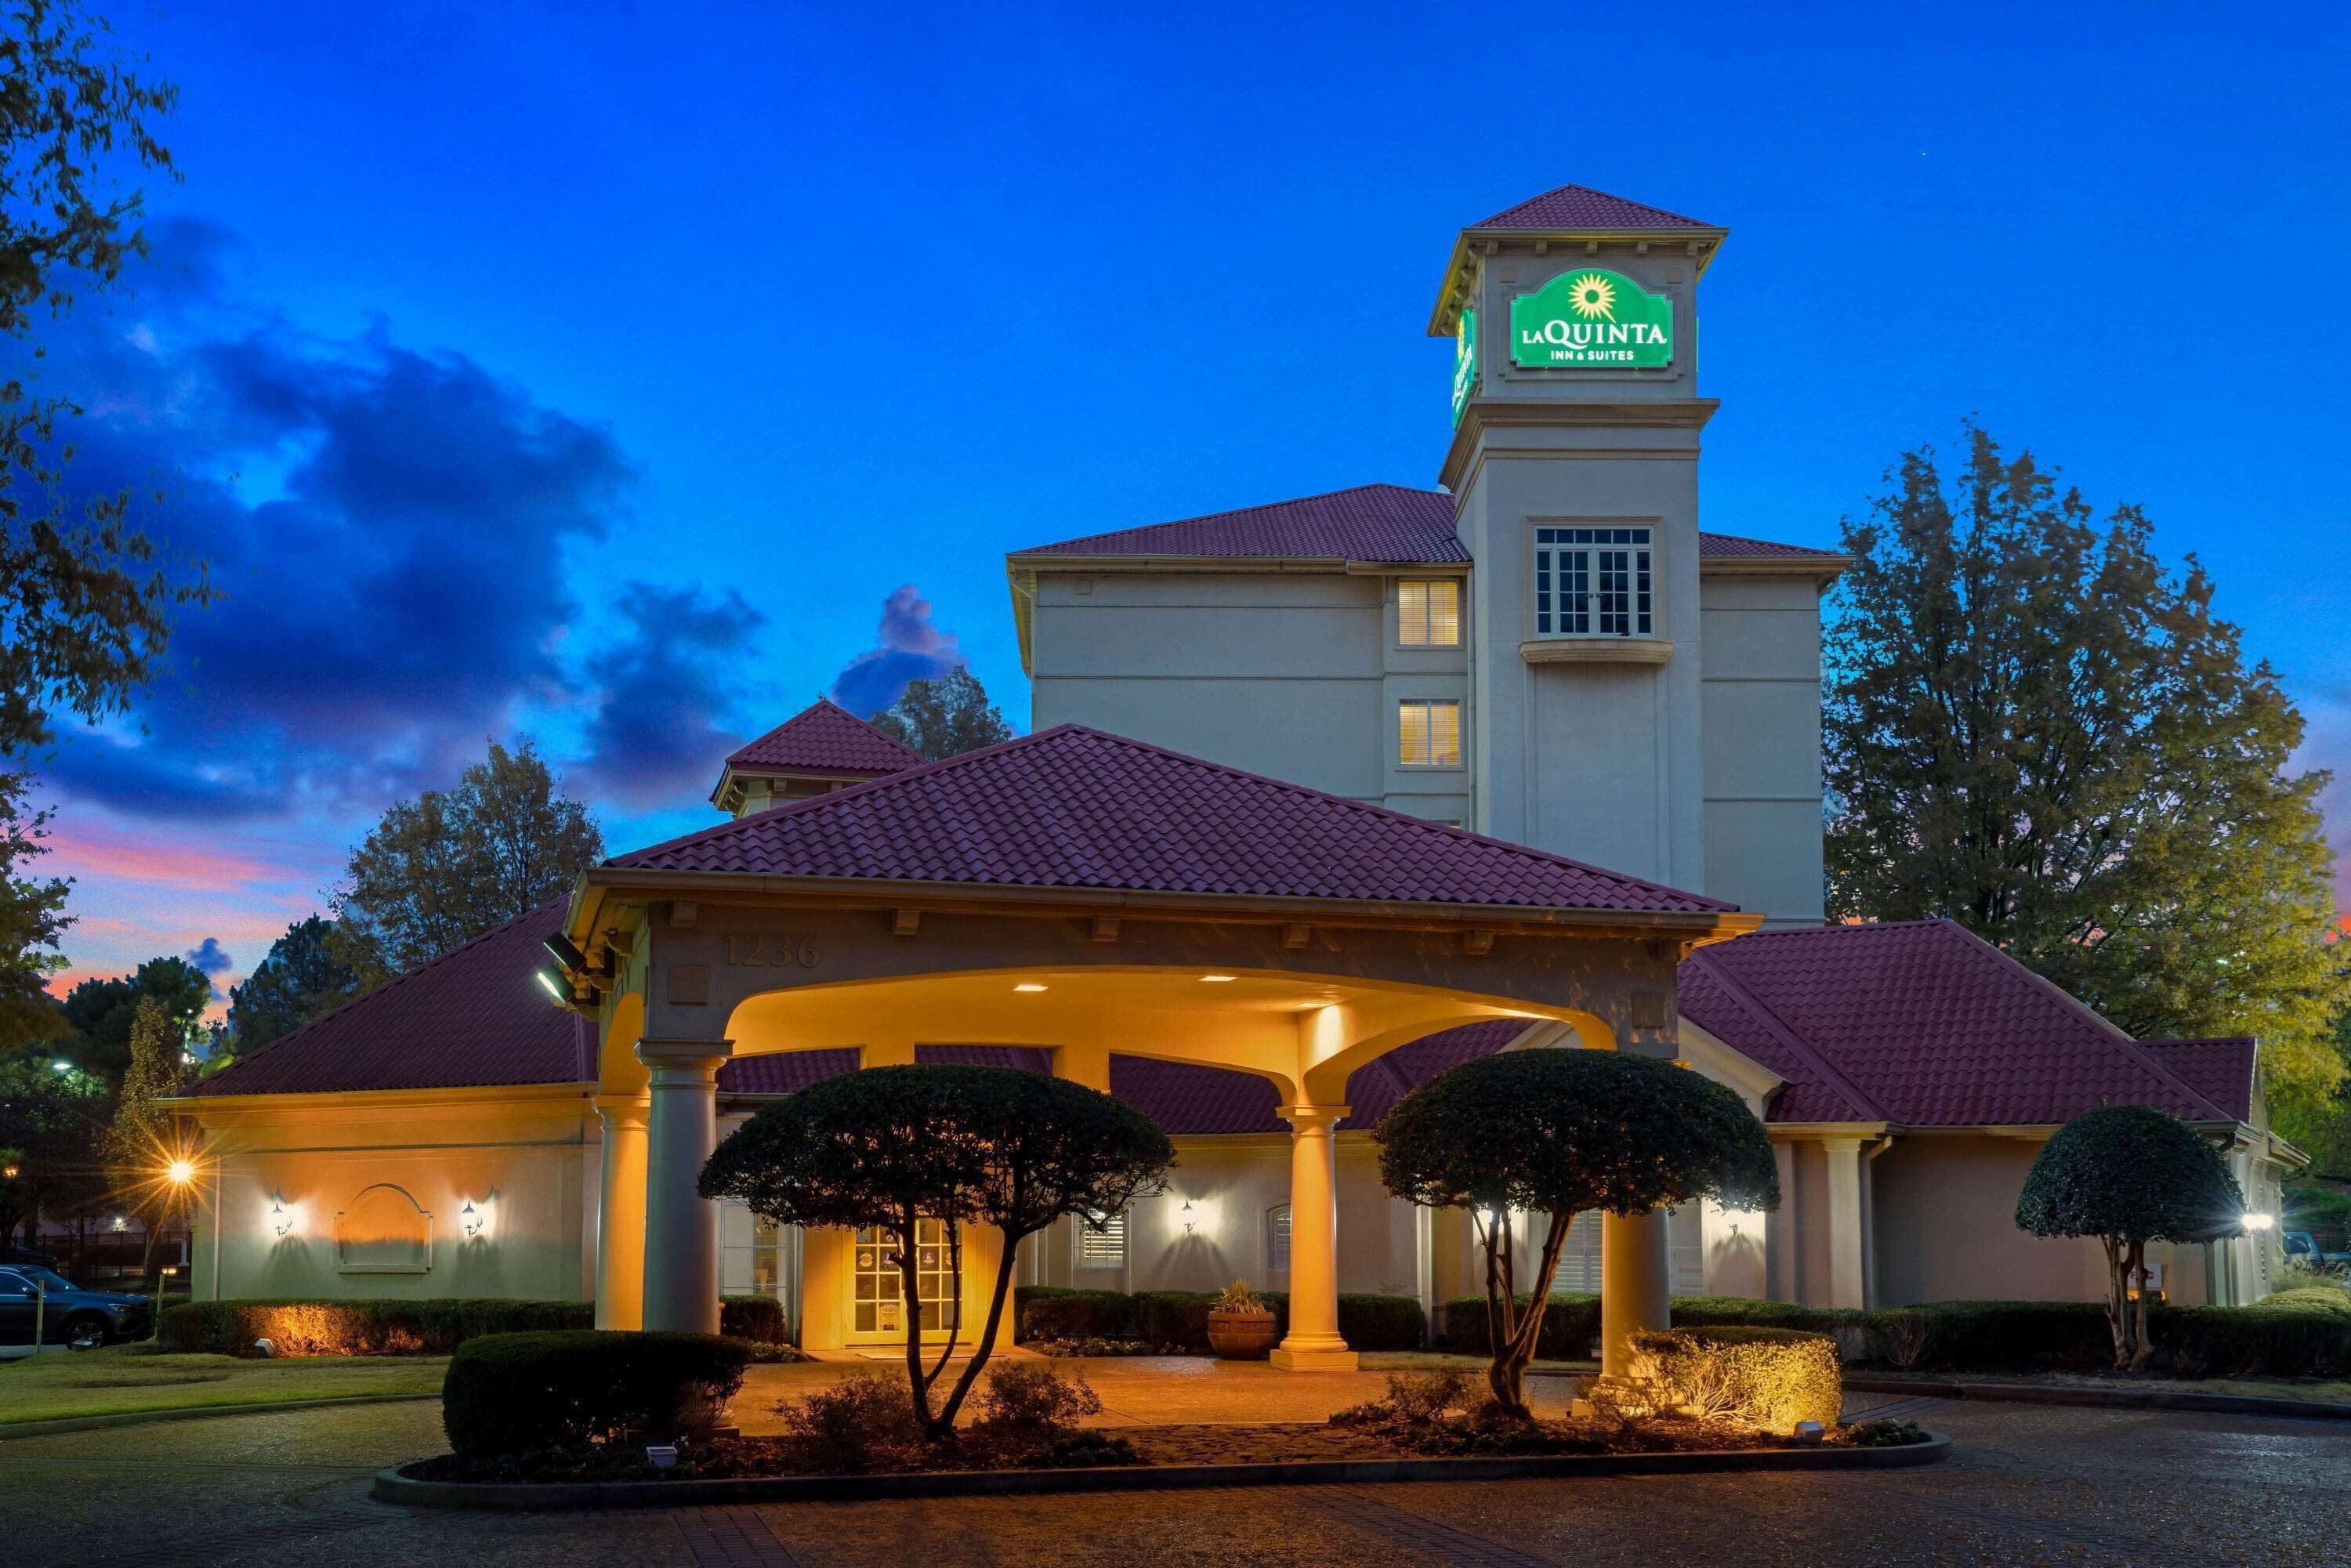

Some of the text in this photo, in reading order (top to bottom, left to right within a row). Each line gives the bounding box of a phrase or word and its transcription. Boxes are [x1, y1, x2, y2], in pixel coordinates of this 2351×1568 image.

[1550, 350, 1635, 360] INN & SUITES
[723, 933, 820, 969] 1236
